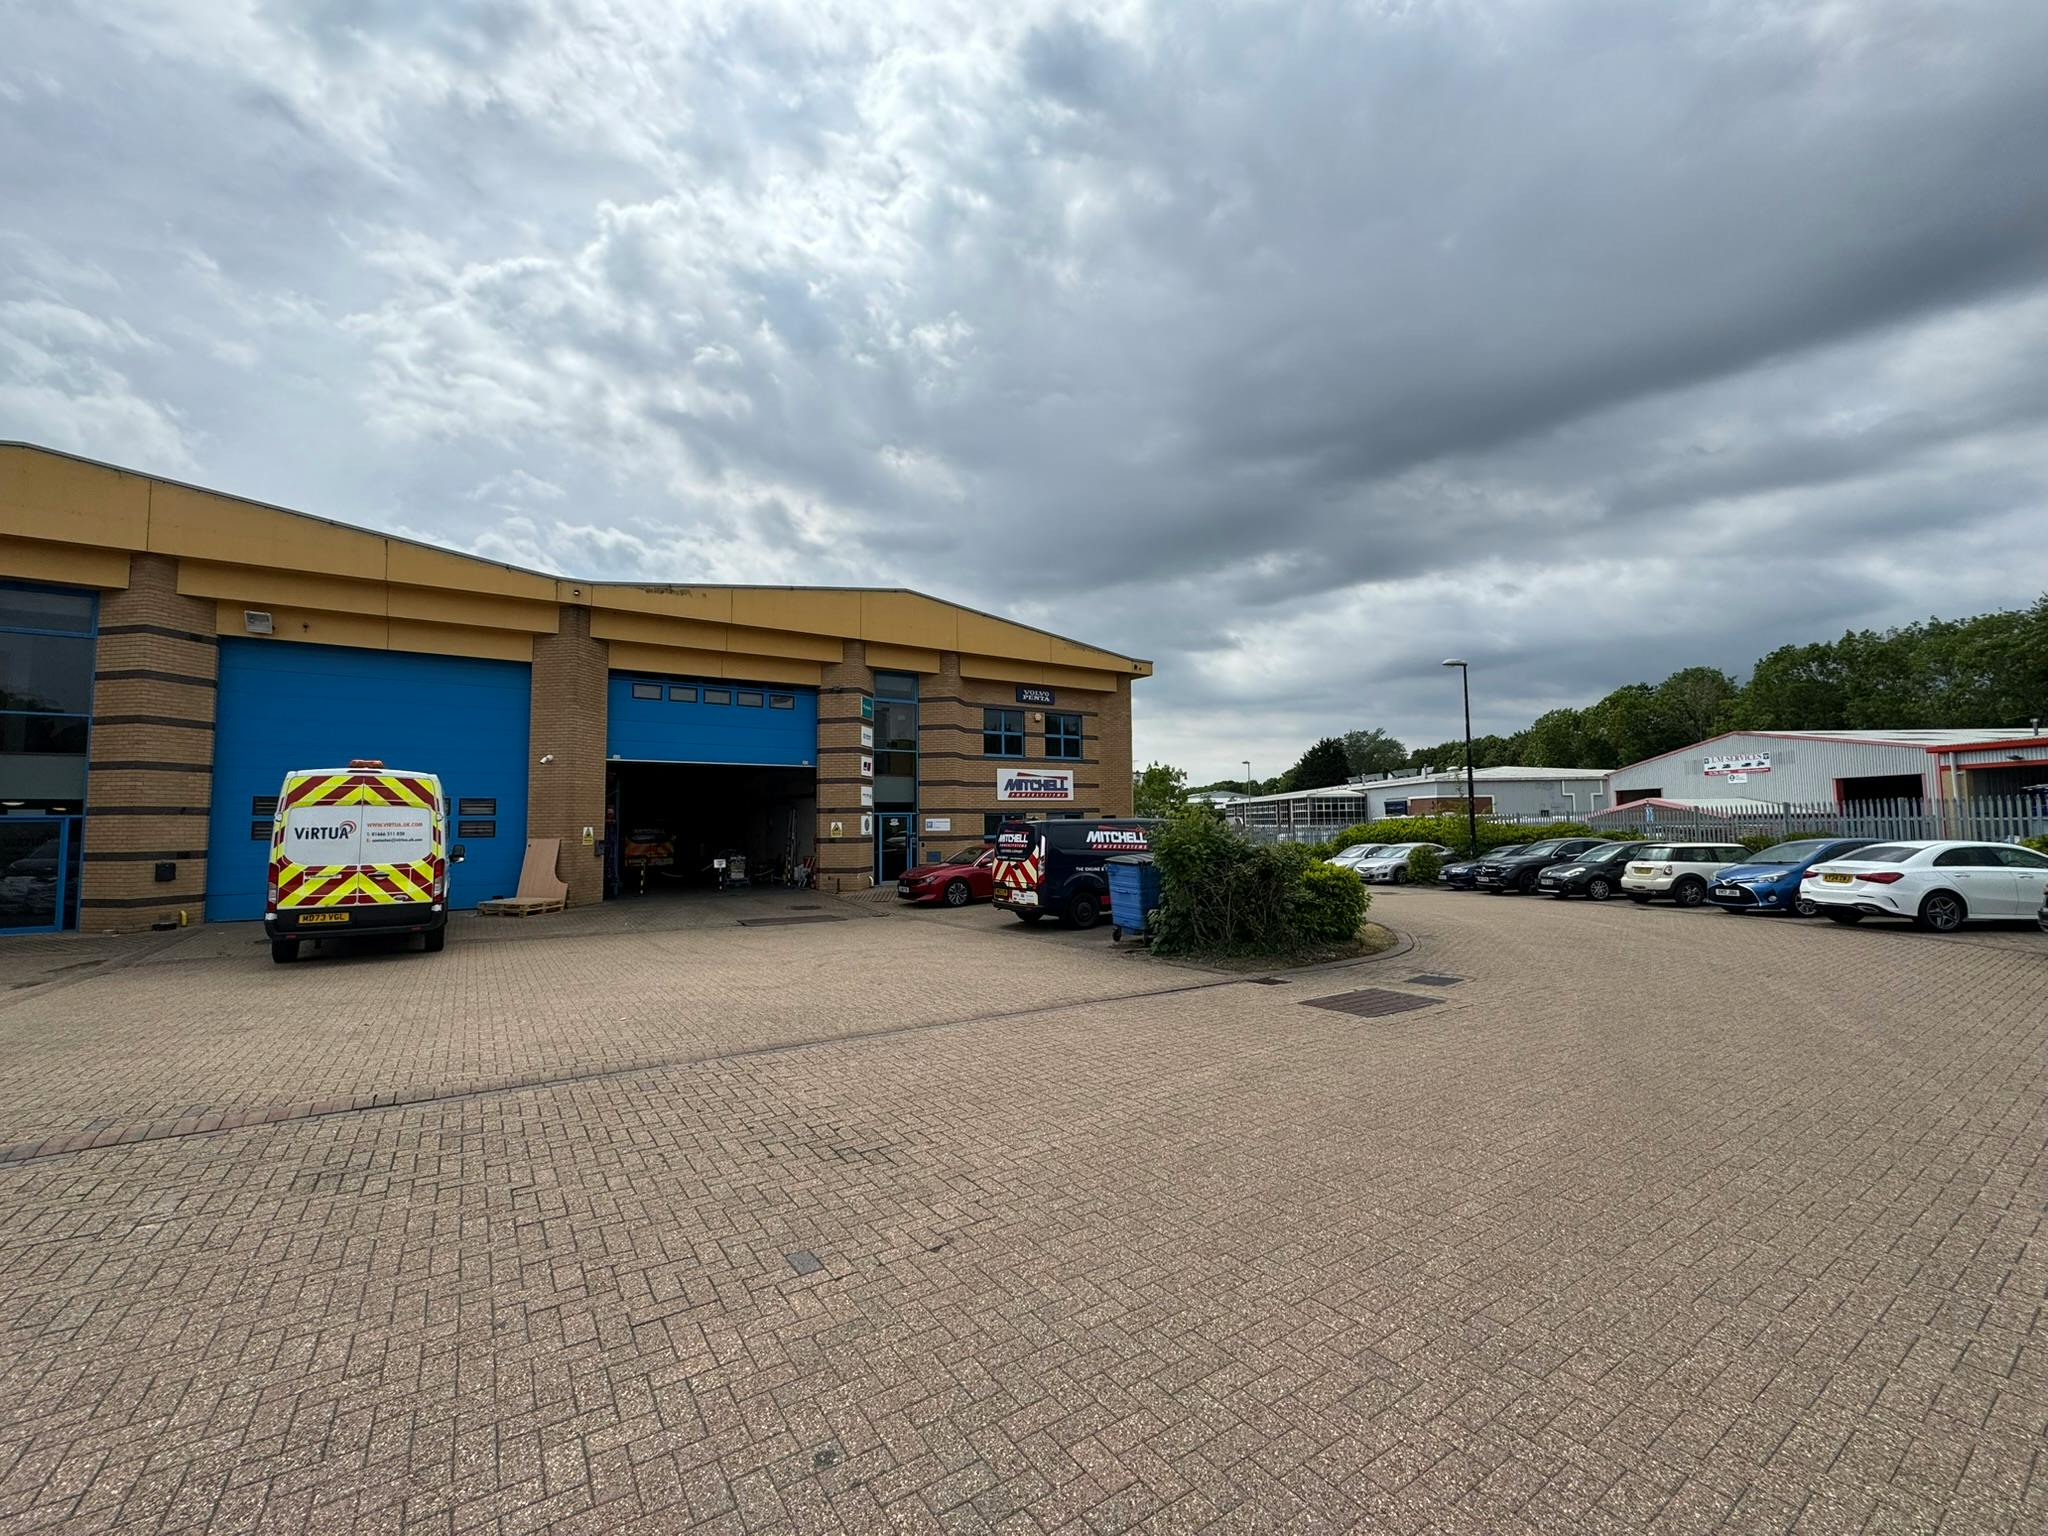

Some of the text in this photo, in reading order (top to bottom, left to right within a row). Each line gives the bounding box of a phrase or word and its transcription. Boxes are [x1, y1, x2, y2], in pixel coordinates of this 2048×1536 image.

[1022, 694, 1050, 702] PENTA
[1023, 689, 1050, 697] VOLVO
[1004, 778, 1069, 791] MITCHELL
[998, 833, 1029, 843] MITCHELL
[1085, 830, 1148, 843] MITCHELL
